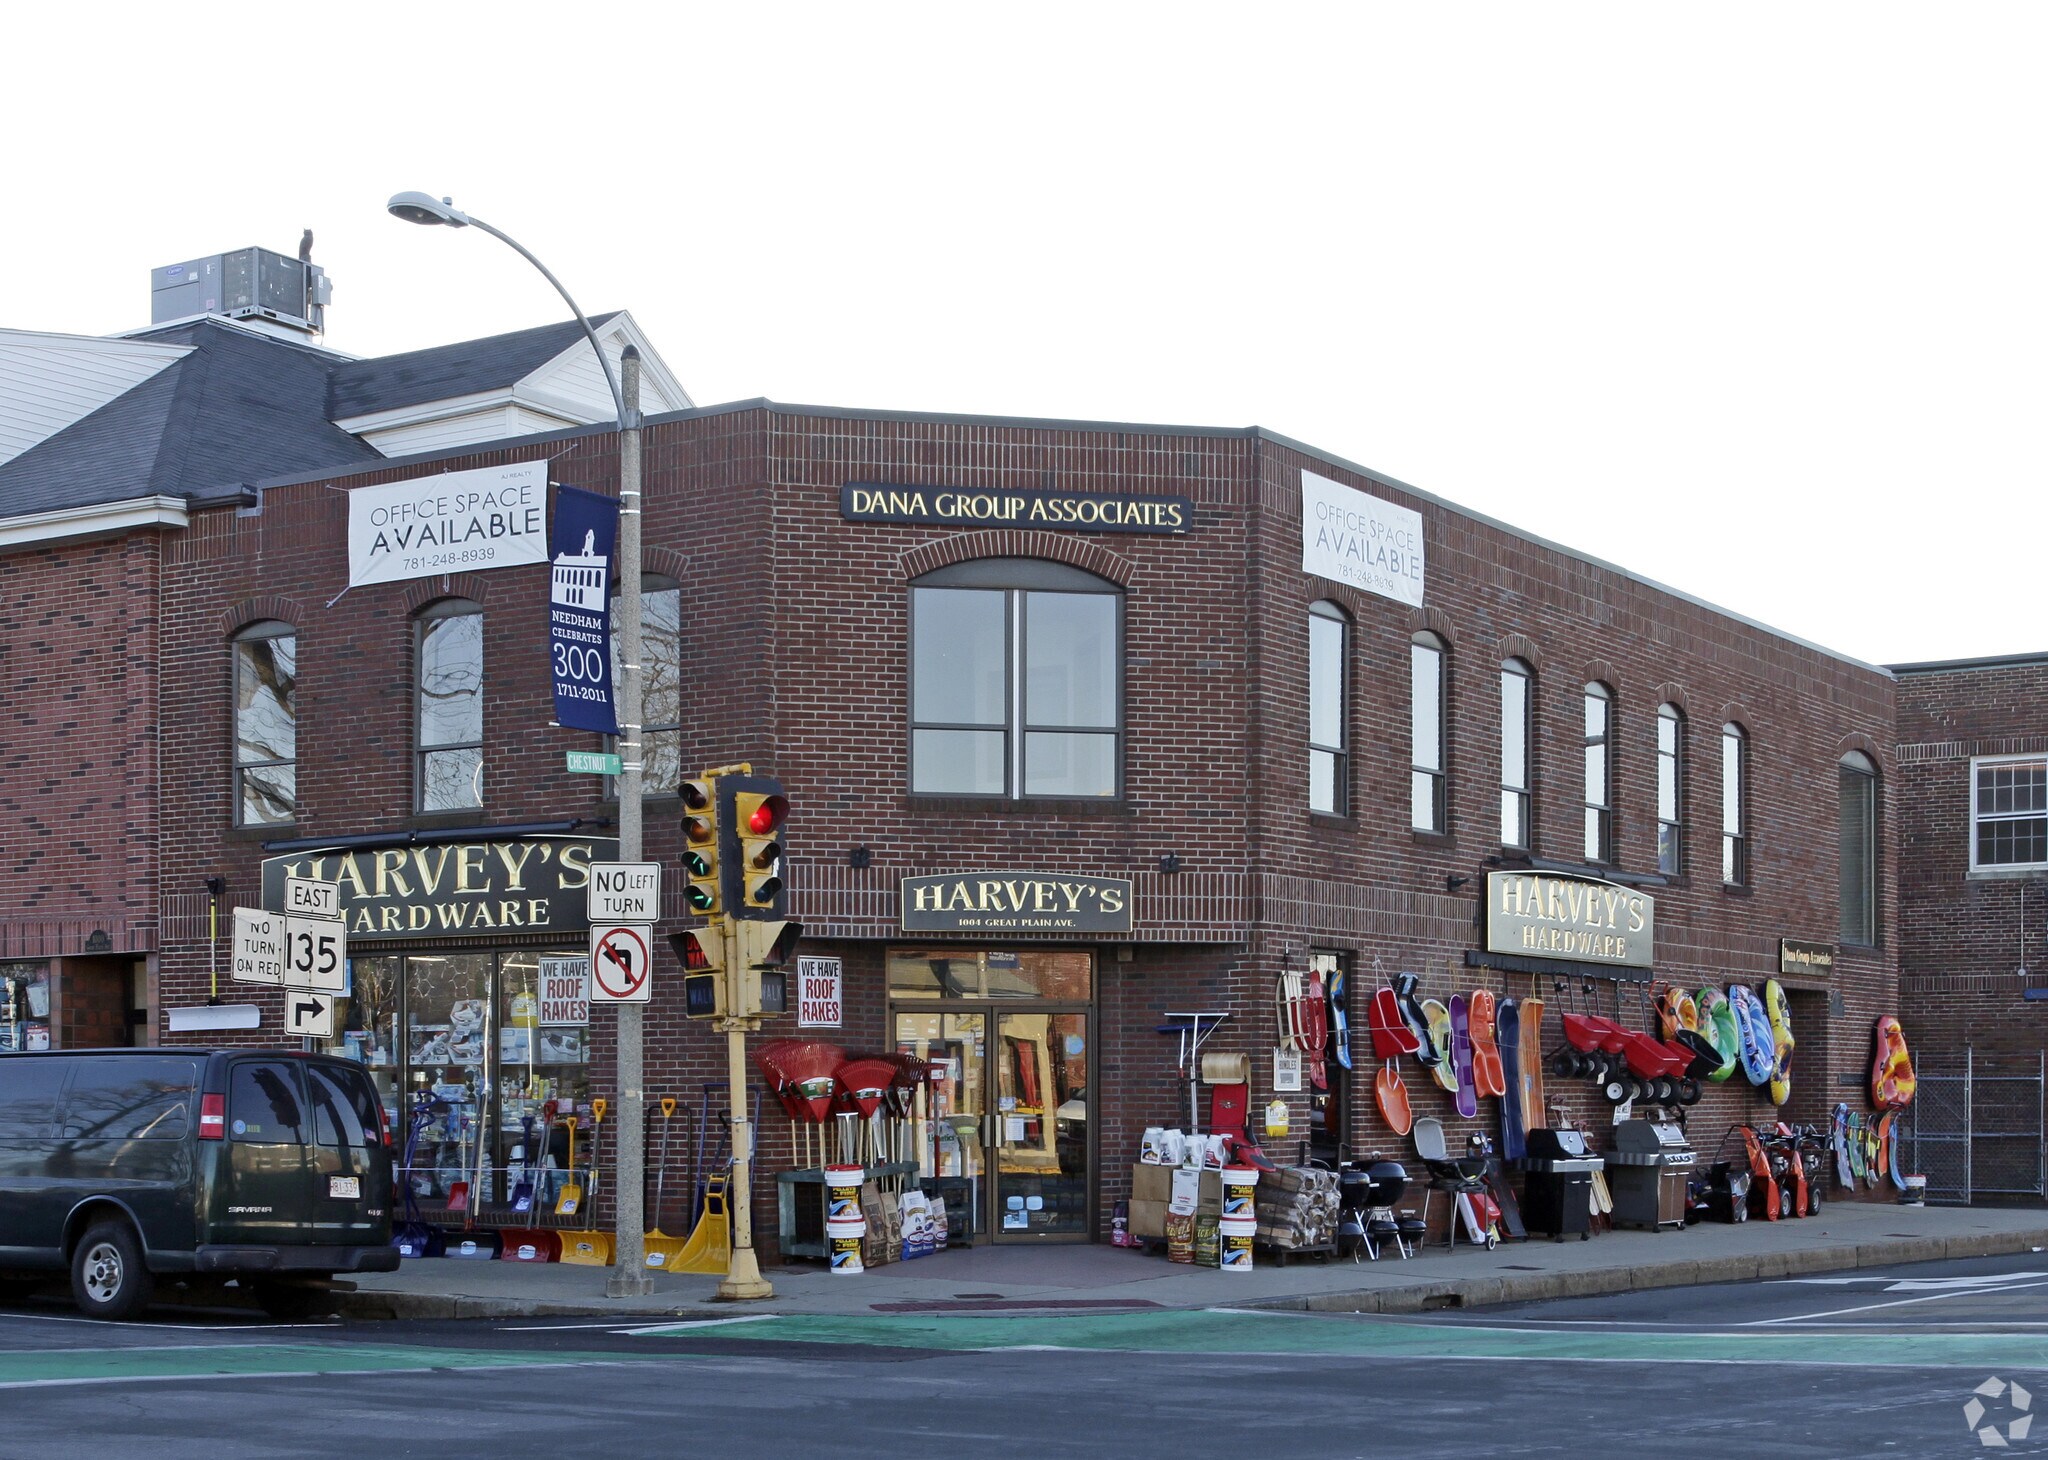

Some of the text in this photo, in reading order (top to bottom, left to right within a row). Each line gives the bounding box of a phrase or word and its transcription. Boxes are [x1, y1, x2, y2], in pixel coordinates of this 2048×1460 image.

[509, 470, 532, 479] REALTY
[371, 485, 532, 527] OFFICE SPACE
[852, 490, 1183, 526] DANA GROUP ASSOCIATES
[370, 508, 540, 556] AVAILABLE
[1316, 501, 1414, 552] OFFICE SPACE
[403, 547, 495, 571] 781-248-8939
[1316, 525, 1420, 580] AVAILABLE
[552, 610, 602, 630] NEEDHAM
[552, 627, 602, 644] CELEBRATES
[553, 642, 603, 683] 300
[568, 754, 620, 771] CHESTNUT ST
[596, 871, 655, 892] NO LEFT
[294, 886, 331, 908] EAST
[604, 898, 644, 912] TURN
[913, 879, 1124, 913] HARVEY'S
[1501, 876, 1645, 933] HARVEY'S
[340, 898, 550, 933] ARDWARE
[958, 918, 1076, 927] 1004 GREAT PLAIN AVE.
[251, 921, 270, 935] NO
[244, 939, 275, 956] TURN
[1522, 924, 1626, 959] HARDWARE
[287, 932, 336, 974] 135
[237, 958, 281, 976] ON RED
[543, 961, 588, 977] WE HAVE
[801, 961, 839, 977] WE HAVE
[547, 978, 583, 998] ROOF
[806, 978, 836, 999] ROOF
[542, 1001, 587, 1021] RAKES
[802, 1001, 839, 1022] RAKES
